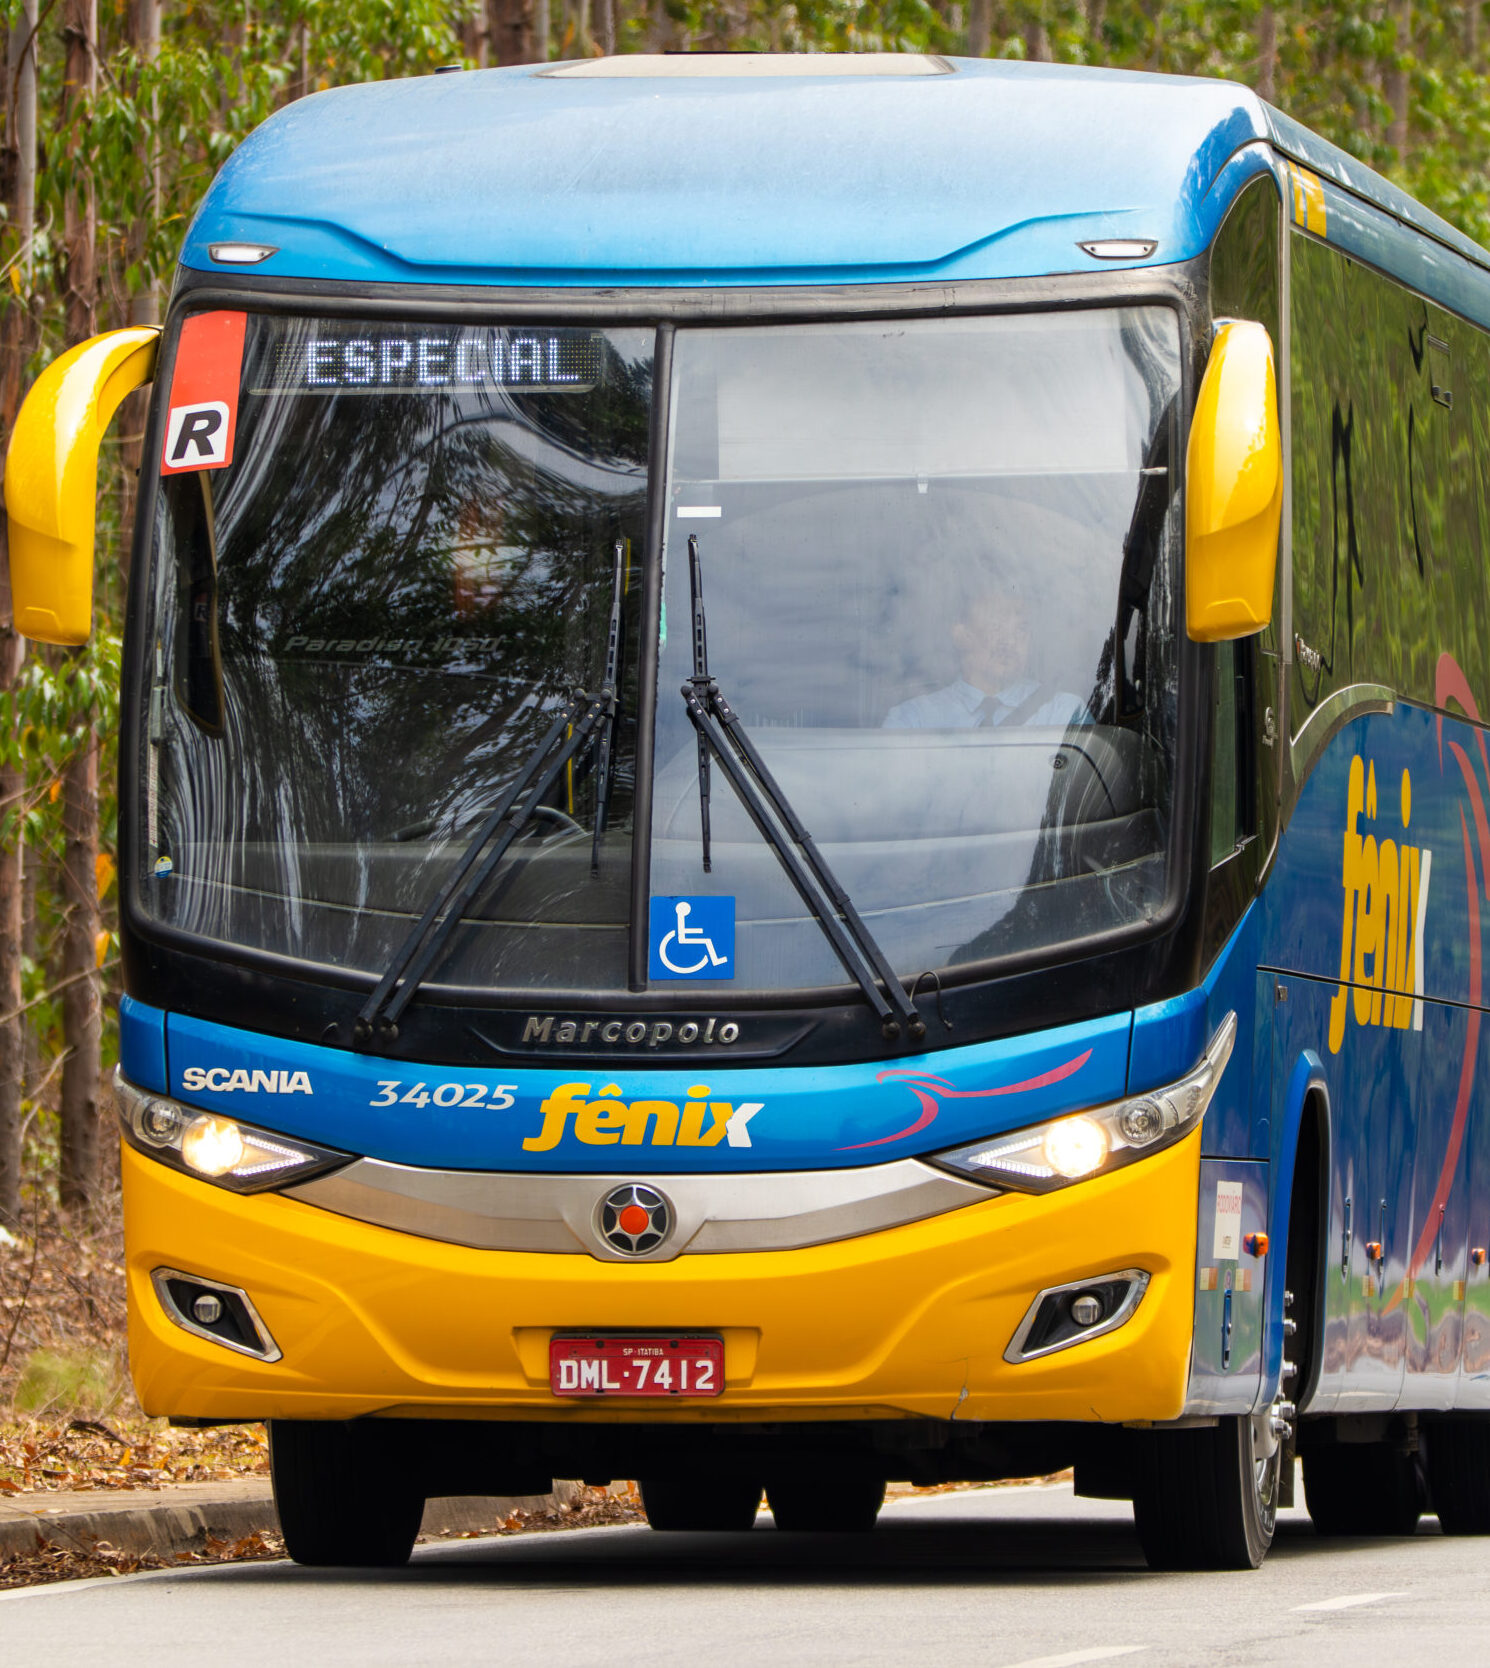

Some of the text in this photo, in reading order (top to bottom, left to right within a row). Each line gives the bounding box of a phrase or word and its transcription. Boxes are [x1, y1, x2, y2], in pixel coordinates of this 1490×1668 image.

[306, 338, 579, 384] ESPECIAL
[171, 409, 222, 461] R
[1328, 754, 1432, 1055] fênix
[521, 1016, 740, 1047] Marcopolo
[182, 1067, 313, 1095] SCANIA
[369, 1080, 518, 1110] 34025
[521, 1082, 765, 1152] fênix
